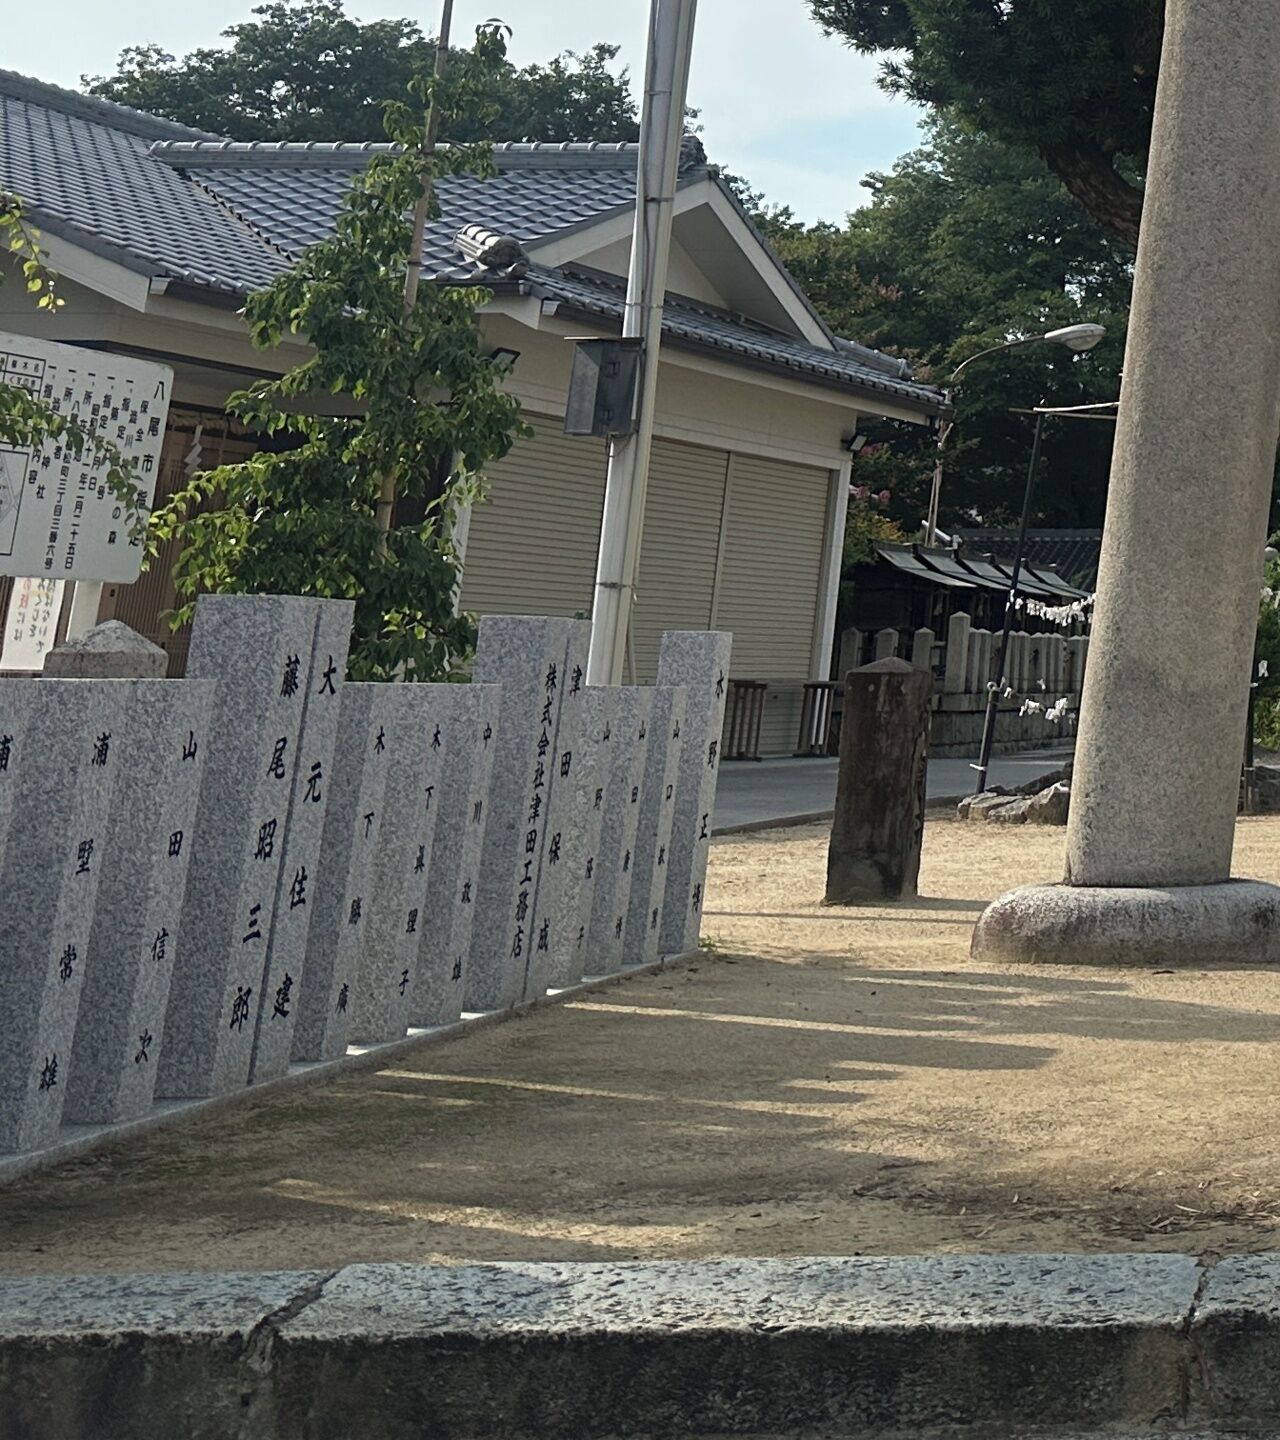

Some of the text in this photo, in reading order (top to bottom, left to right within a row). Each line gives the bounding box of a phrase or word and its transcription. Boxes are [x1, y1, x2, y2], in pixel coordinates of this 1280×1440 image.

[135, 729, 198, 1064] 山田信次
[229, 654, 301, 1033] 藤尾昭三郎
[510, 662, 558, 959] 株式会社津田工務店
[536, 664, 583, 953] 津田保成
